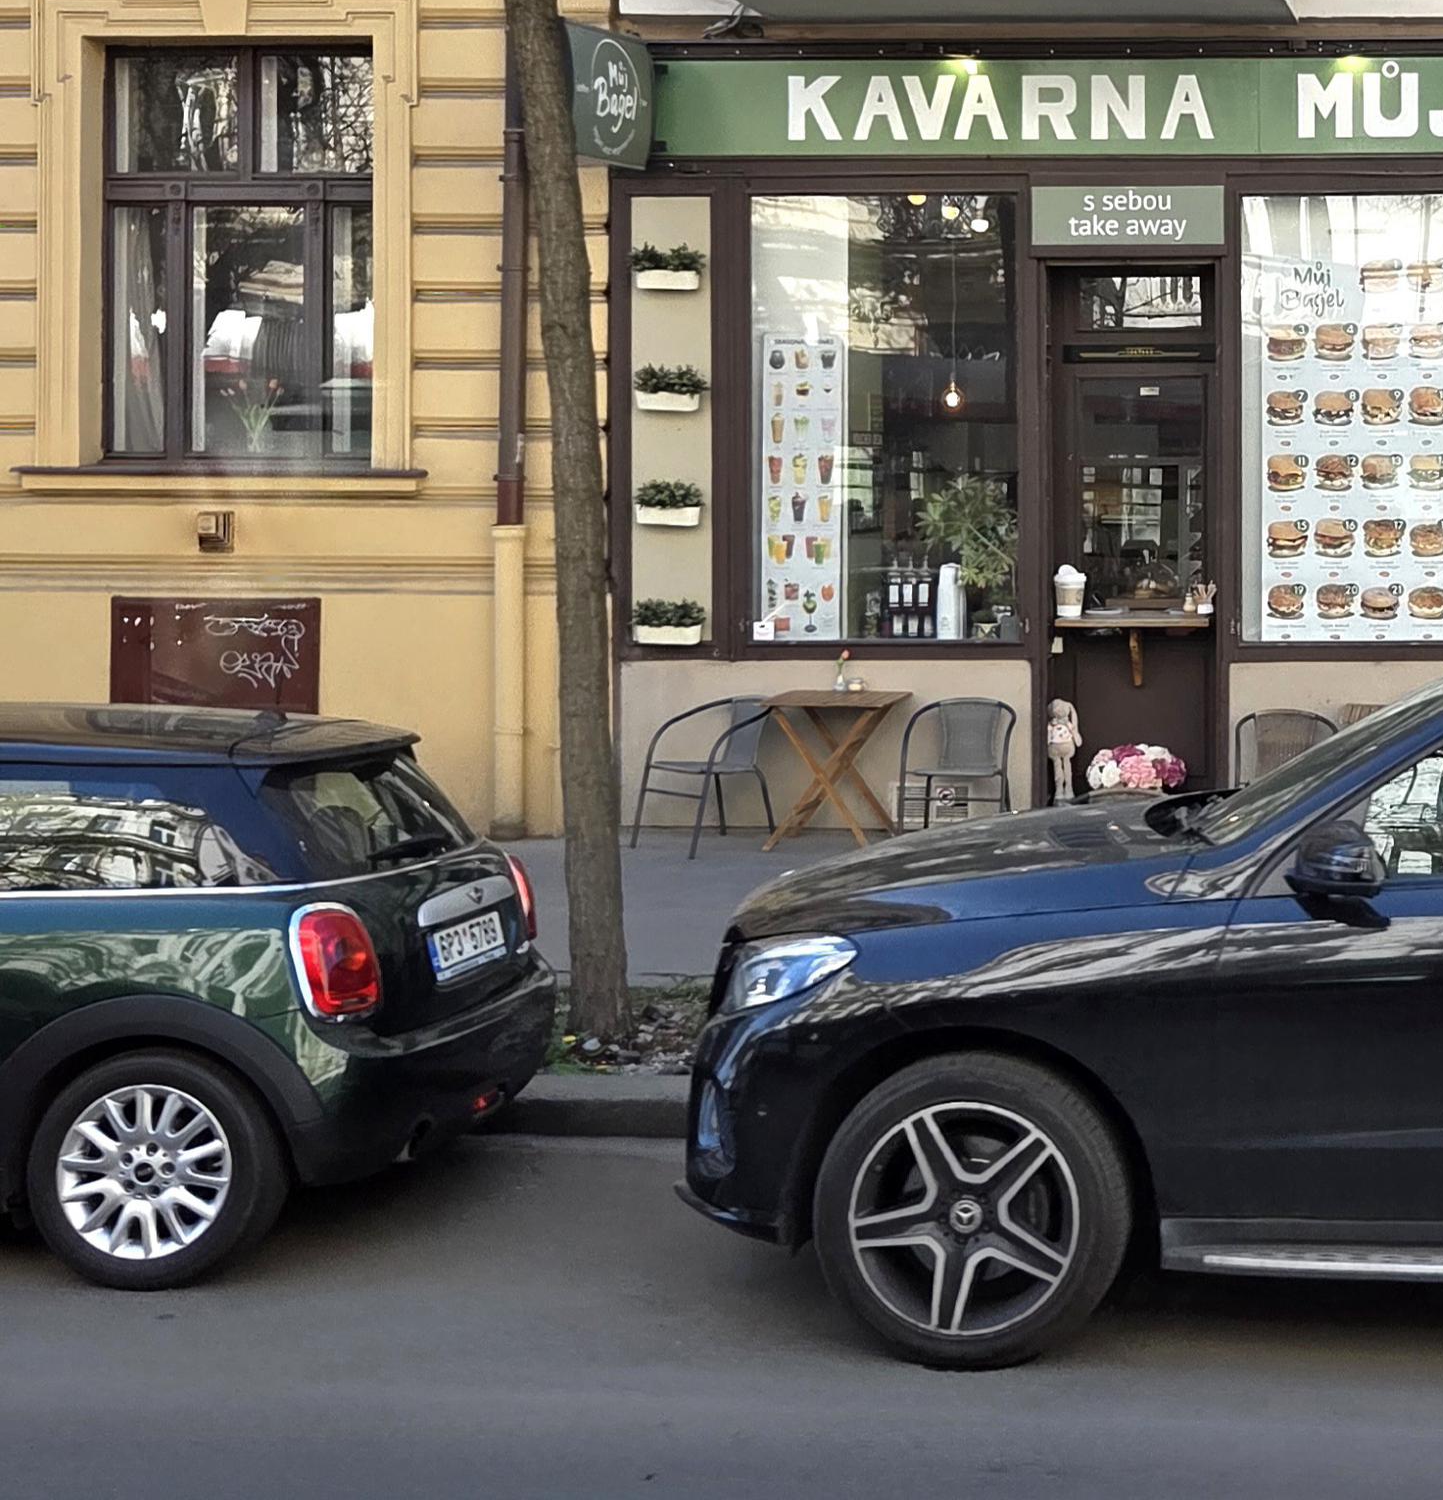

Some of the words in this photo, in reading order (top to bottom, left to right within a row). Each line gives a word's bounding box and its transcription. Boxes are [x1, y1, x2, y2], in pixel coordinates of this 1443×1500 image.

[594, 76, 638, 133] Bagel
[1083, 194, 1095, 211] s
[1102, 189, 1172, 212] sebou
[1068, 214, 1119, 236] take
[1126, 218, 1187, 241] away
[1294, 260, 1331, 293] Můj
[1280, 288, 1345, 317] Bagel
